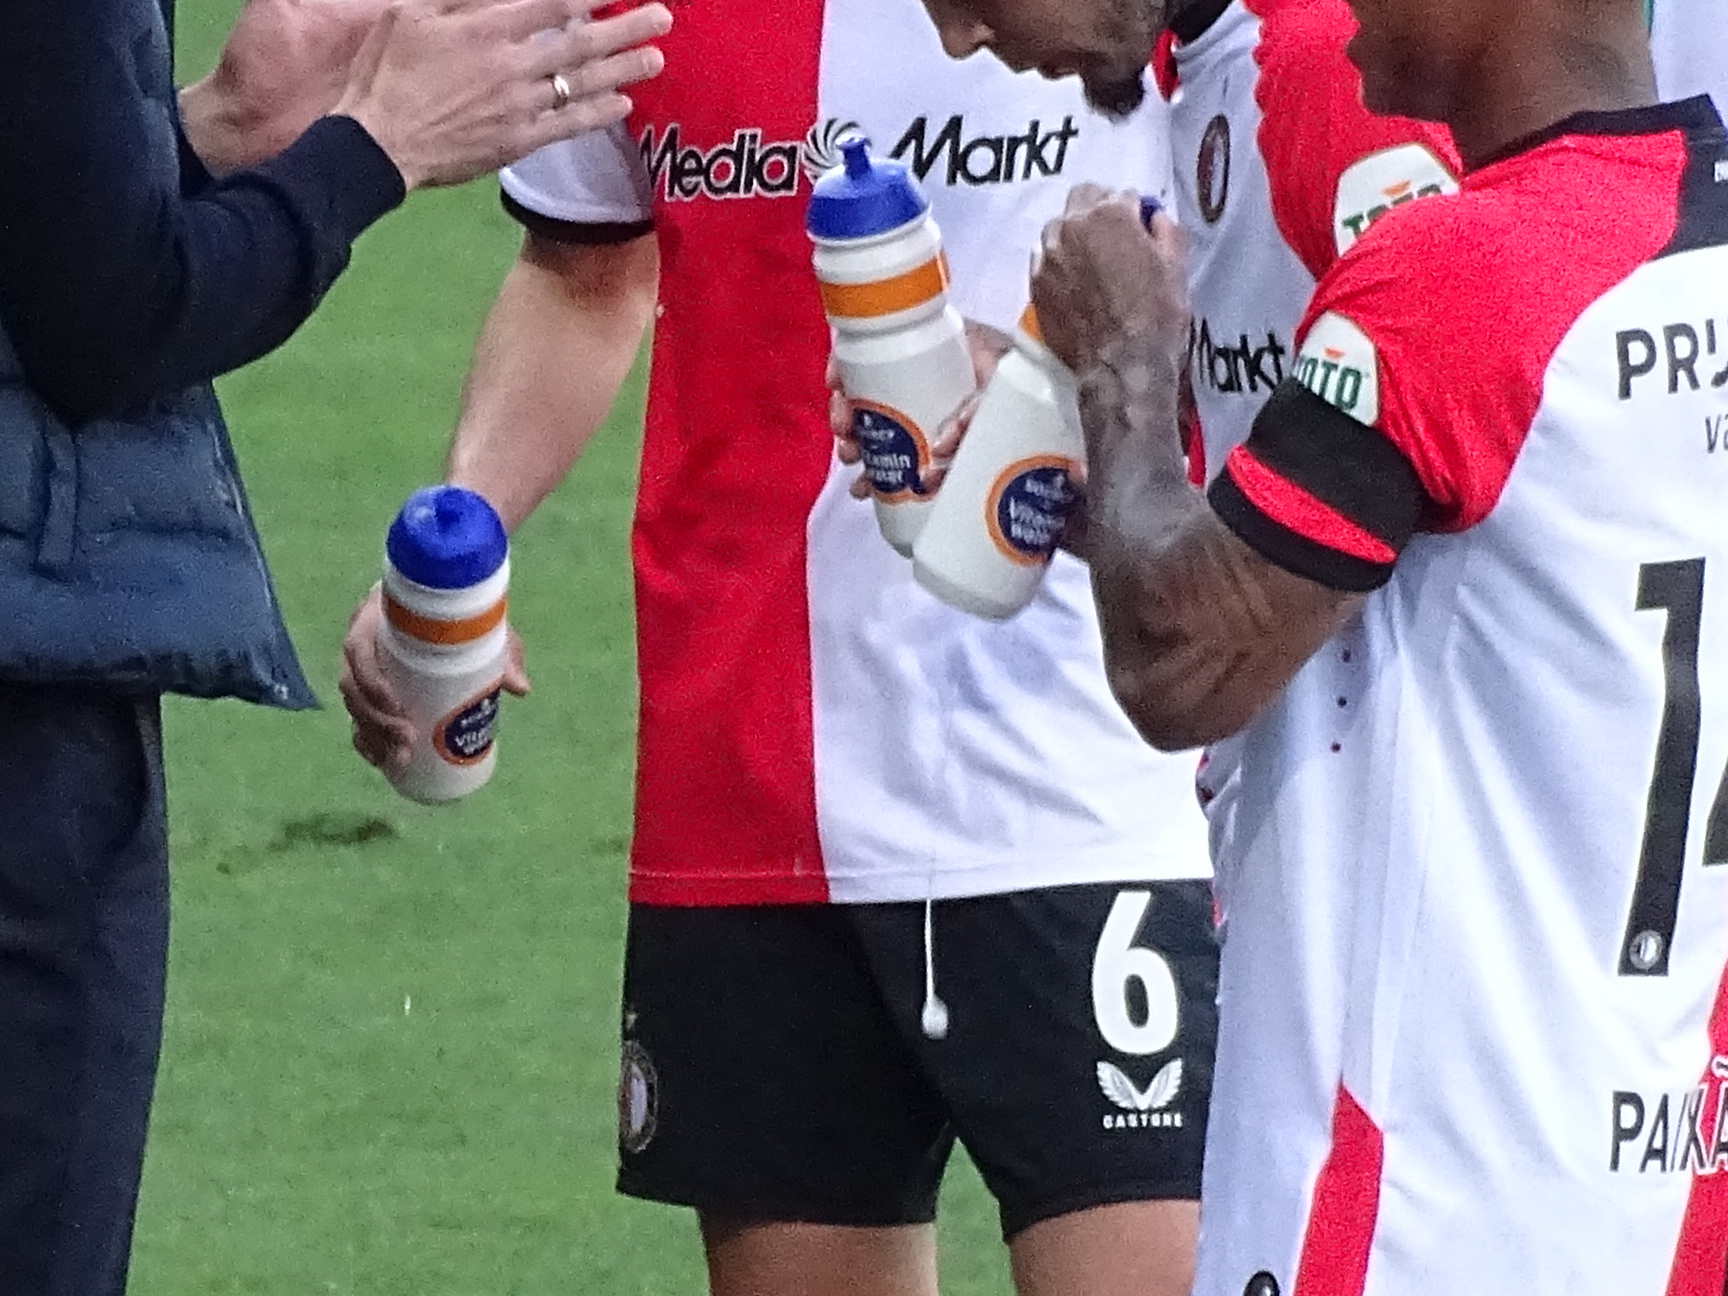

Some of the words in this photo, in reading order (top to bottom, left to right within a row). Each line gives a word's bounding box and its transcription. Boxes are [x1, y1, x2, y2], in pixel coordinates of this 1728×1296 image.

[640, 122, 799, 201] Media
[888, 114, 1078, 186] Markt
[1294, 356, 1363, 411] OTO
[1091, 890, 1178, 1055] 6
